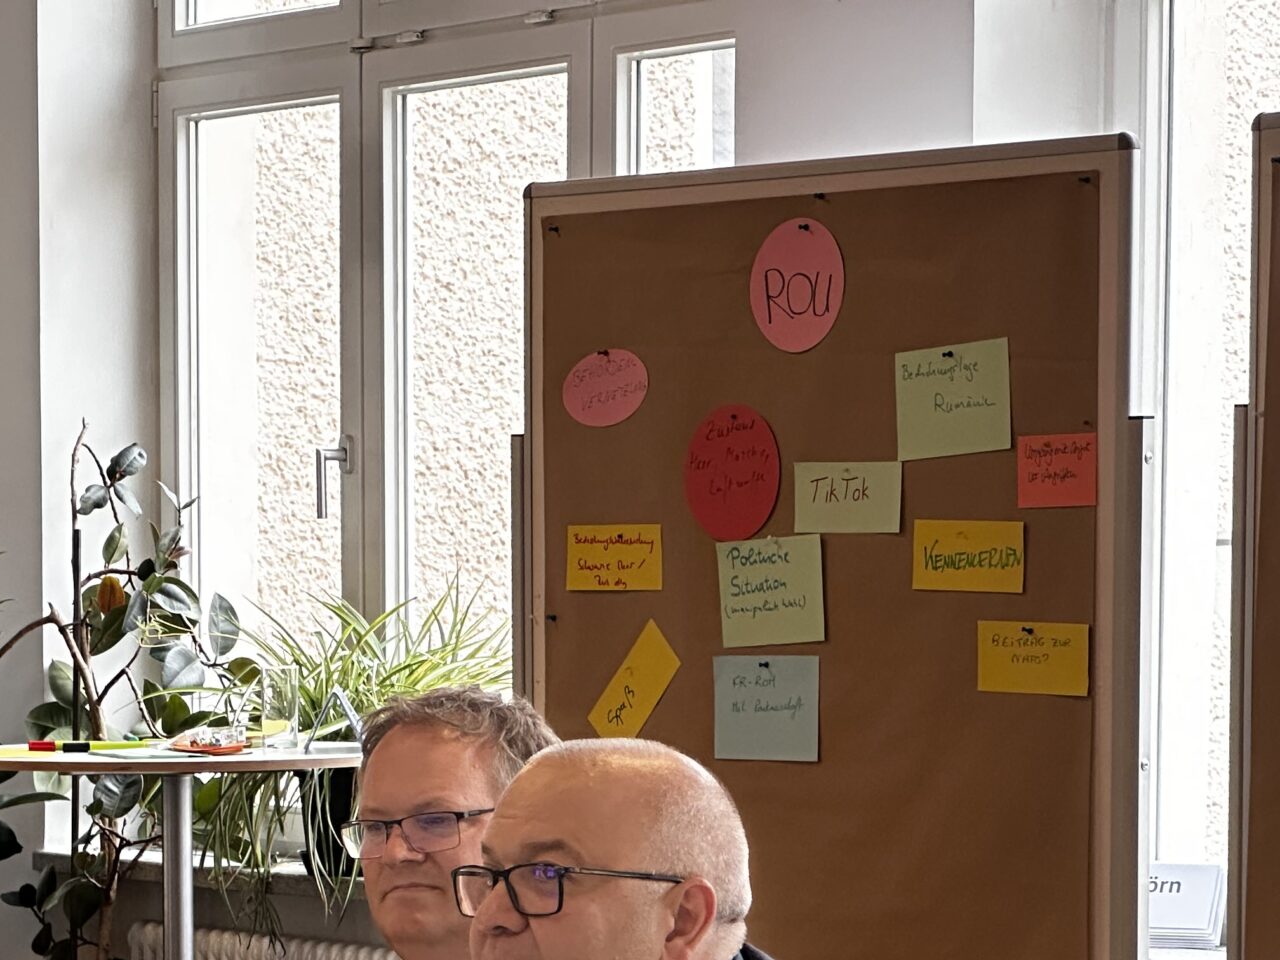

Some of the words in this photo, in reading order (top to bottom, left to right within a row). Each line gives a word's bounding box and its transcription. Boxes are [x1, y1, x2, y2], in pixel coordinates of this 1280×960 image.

[764, 267, 832, 325] ROU
[810, 476, 870, 503] TikTok
[730, 574, 788, 598] Situation
